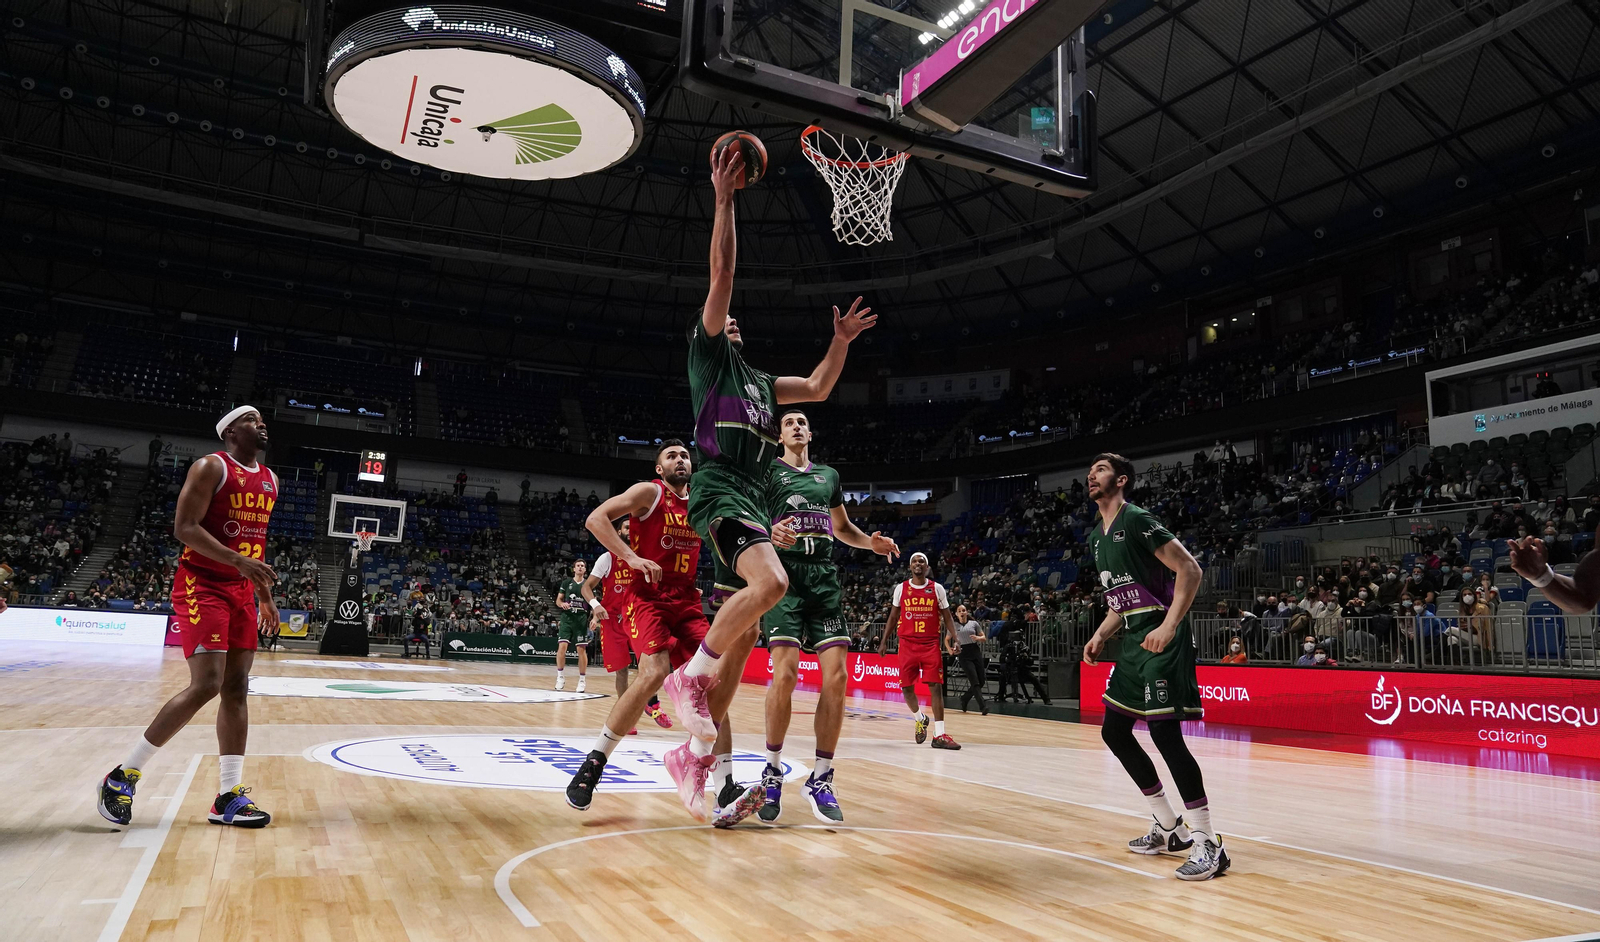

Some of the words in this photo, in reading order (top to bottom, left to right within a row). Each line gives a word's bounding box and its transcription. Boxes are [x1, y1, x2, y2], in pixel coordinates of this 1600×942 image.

[432, 20, 555, 48] FundaciónUnicaja
[958, 0, 1028, 59] end
[410, 84, 465, 149] Unicaja
[1548, 405, 1559, 414] de
[1561, 399, 1594, 412] Málaga
[368, 451, 386, 460] 2:38
[365, 460, 383, 475] 19
[229, 491, 275, 512] UCAM
[228, 508, 270, 523] UNIVERSID
[238, 541, 263, 560] 22
[803, 538, 815, 555] 11
[674, 553, 690, 573] 15
[903, 597, 934, 607] UCAM
[914, 621, 926, 633] 12
[463, 646, 512, 654] FundaciónUnicaja
[865, 664, 883, 675] DOÑA
[883, 666, 900, 677] FRAN
[1198, 685, 1250, 702] CISQUITA
[1408, 694, 1465, 716] DOÑA
[1469, 700, 1600, 728] FRANCISQU
[1478, 728, 1547, 749] catering
